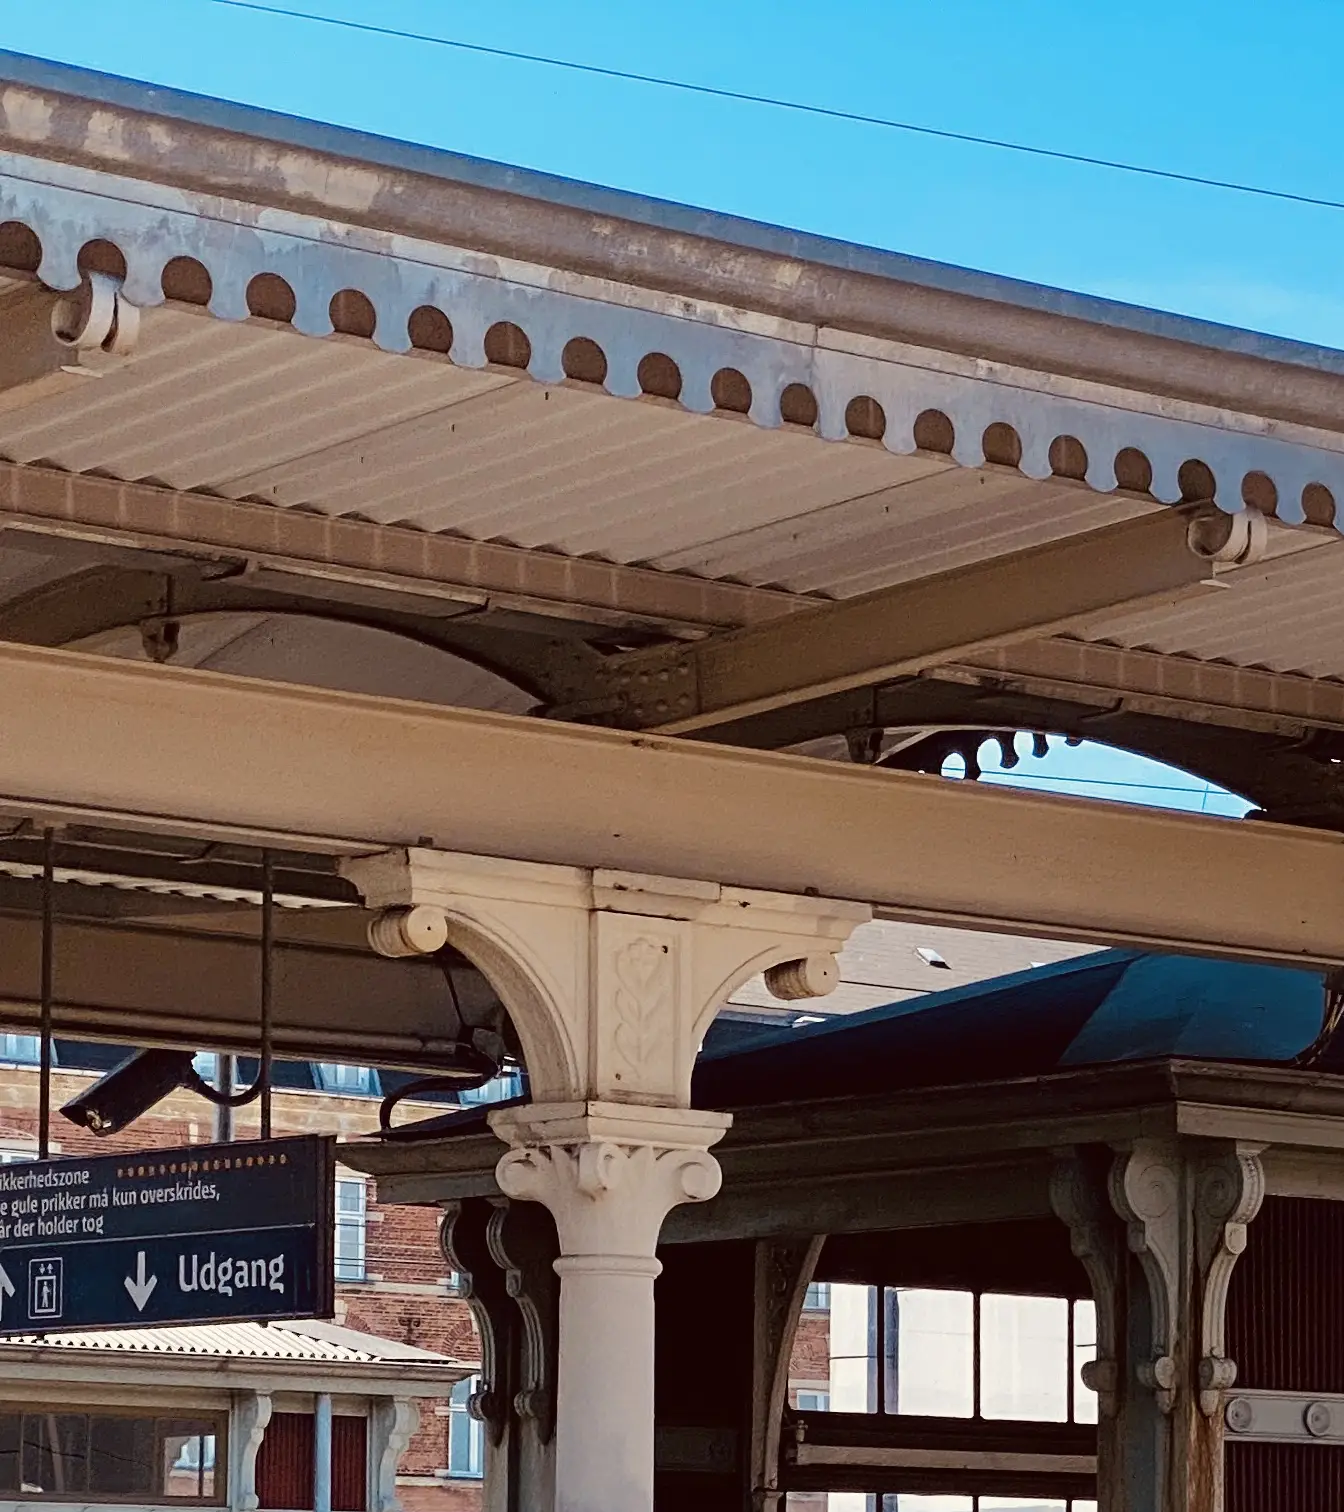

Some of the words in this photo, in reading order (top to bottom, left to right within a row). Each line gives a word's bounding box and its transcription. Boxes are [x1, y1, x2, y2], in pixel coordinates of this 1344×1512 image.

[11, 1194, 38, 1218] gule
[41, 1191, 87, 1216] prikker
[89, 1186, 109, 1208] må
[112, 1184, 137, 1206] kun
[140, 1180, 220, 1204] overskrides,
[13, 1218, 36, 1238] der
[37, 1215, 80, 1236] holder
[82, 1214, 104, 1235] tog
[179, 1251, 285, 1297] Udgang
